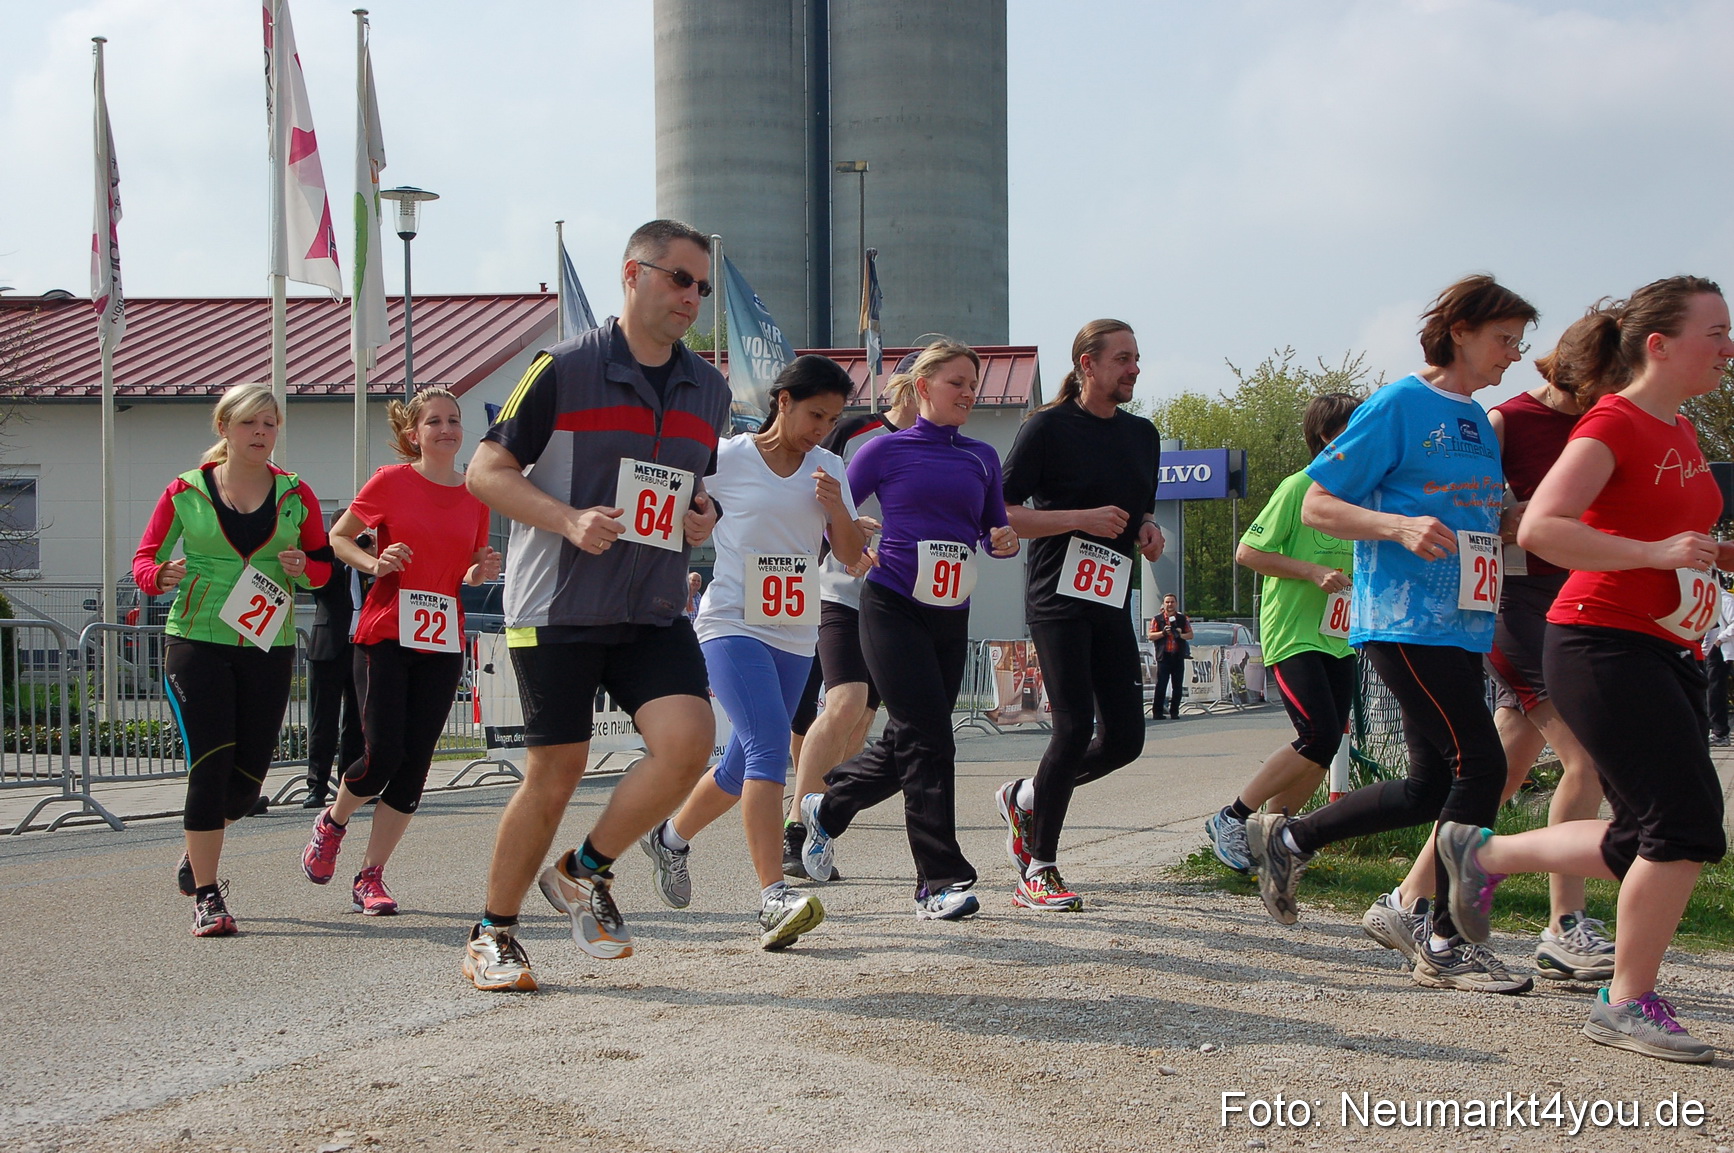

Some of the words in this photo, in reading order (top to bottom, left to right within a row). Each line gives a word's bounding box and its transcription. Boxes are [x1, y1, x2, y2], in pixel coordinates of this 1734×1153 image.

[759, 320, 783, 343] IHR
[741, 336, 785, 362] VOLVO
[634, 464, 669, 480] MEYER
[634, 473, 668, 488] WERBUNG
[1158, 464, 1211, 483] LVO
[634, 489, 676, 541] 64
[930, 543, 959, 553] MEYER
[1080, 542, 1110, 557] MEYER
[1468, 534, 1491, 547] MEYER
[1469, 544, 1492, 554] WERBUNG
[758, 556, 792, 566] MEYER
[930, 550, 959, 559] WERBUNG
[1079, 549, 1109, 562] WERBUNG
[758, 565, 793, 573] WERBUNG
[932, 559, 962, 599] 91
[1073, 558, 1116, 598] 85
[251, 578, 276, 600] WERBUNG
[253, 573, 279, 595] MEYER
[1474, 556, 1498, 605] 26
[410, 593, 438, 603] MEYER
[410, 600, 438, 609] WERBUNG
[762, 575, 805, 617] 95
[1679, 578, 1717, 632] 28
[237, 594, 278, 637] 21
[1329, 597, 1352, 633] 80
[413, 608, 447, 645] 22
